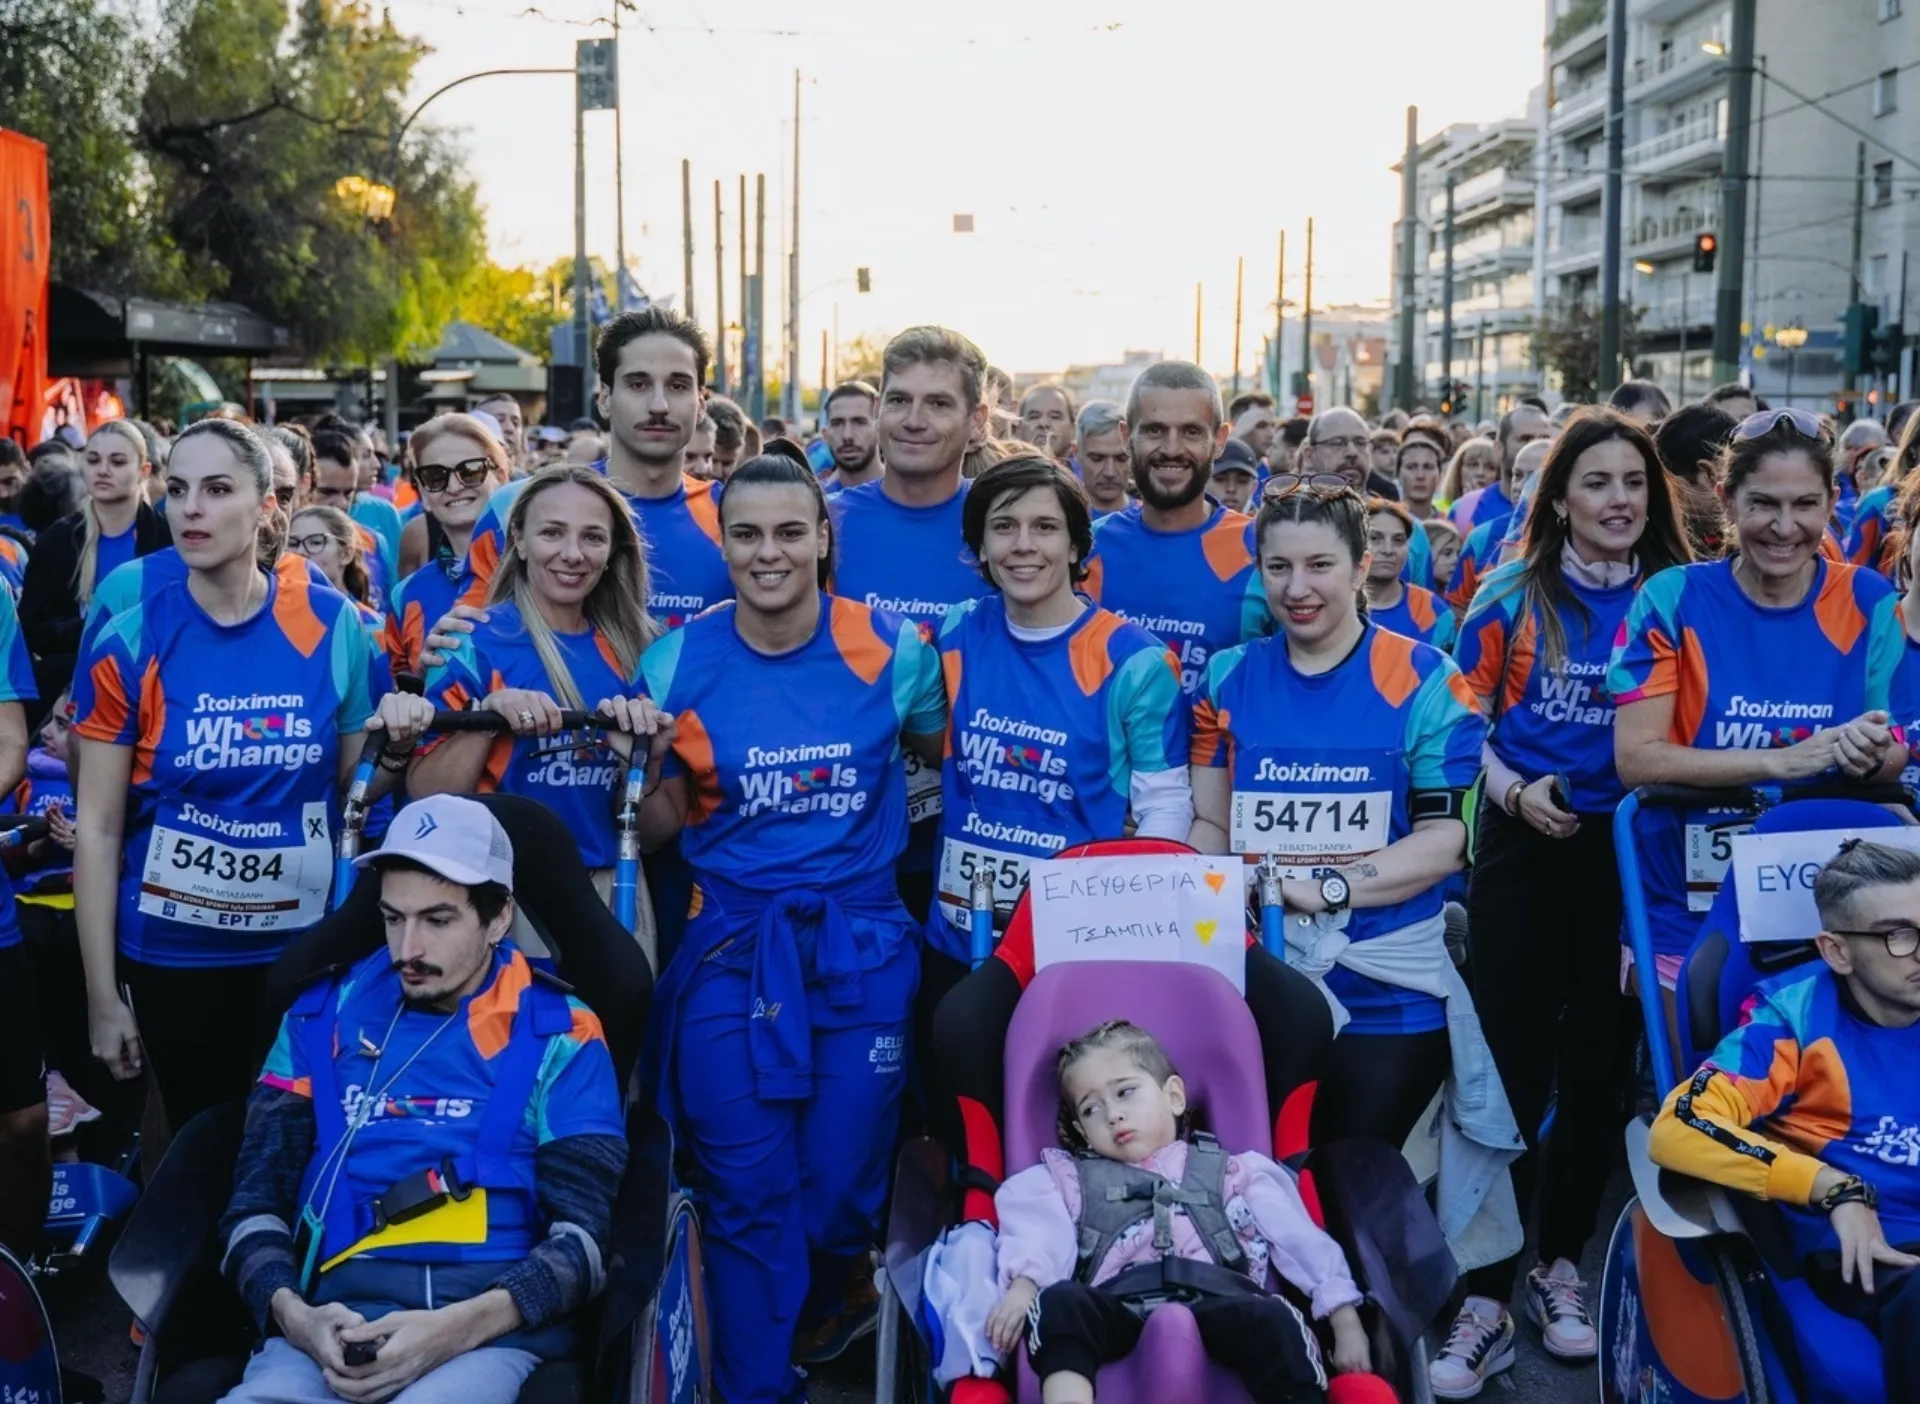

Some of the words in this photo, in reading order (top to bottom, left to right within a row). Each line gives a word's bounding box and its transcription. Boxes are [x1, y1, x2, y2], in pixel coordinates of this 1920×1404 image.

[193, 692, 304, 713] Stoiximan
[1725, 695, 1834, 718] Stoiximan
[186, 712, 312, 745] Wheels
[969, 708, 1068, 747] Stoiximan
[174, 749, 194, 768] of
[194, 743, 323, 771] Change
[744, 742, 852, 769] Stoiximan
[961, 730, 1067, 776] Wheels
[527, 767, 547, 783] of
[739, 763, 858, 799] Wheels
[967, 757, 1075, 804] Change
[749, 790, 867, 817] Change
[1254, 799, 1369, 832] 54714
[961, 812, 1068, 850] Stoiximan
[172, 838, 283, 882] 54384
[1691, 834, 1700, 858] BLOCK
[1042, 872, 1197, 901] ΕΛΕΥΘΕΡΙΑ
[1067, 921, 1181, 944] ΤΣΑΜΠΙΚΑ
